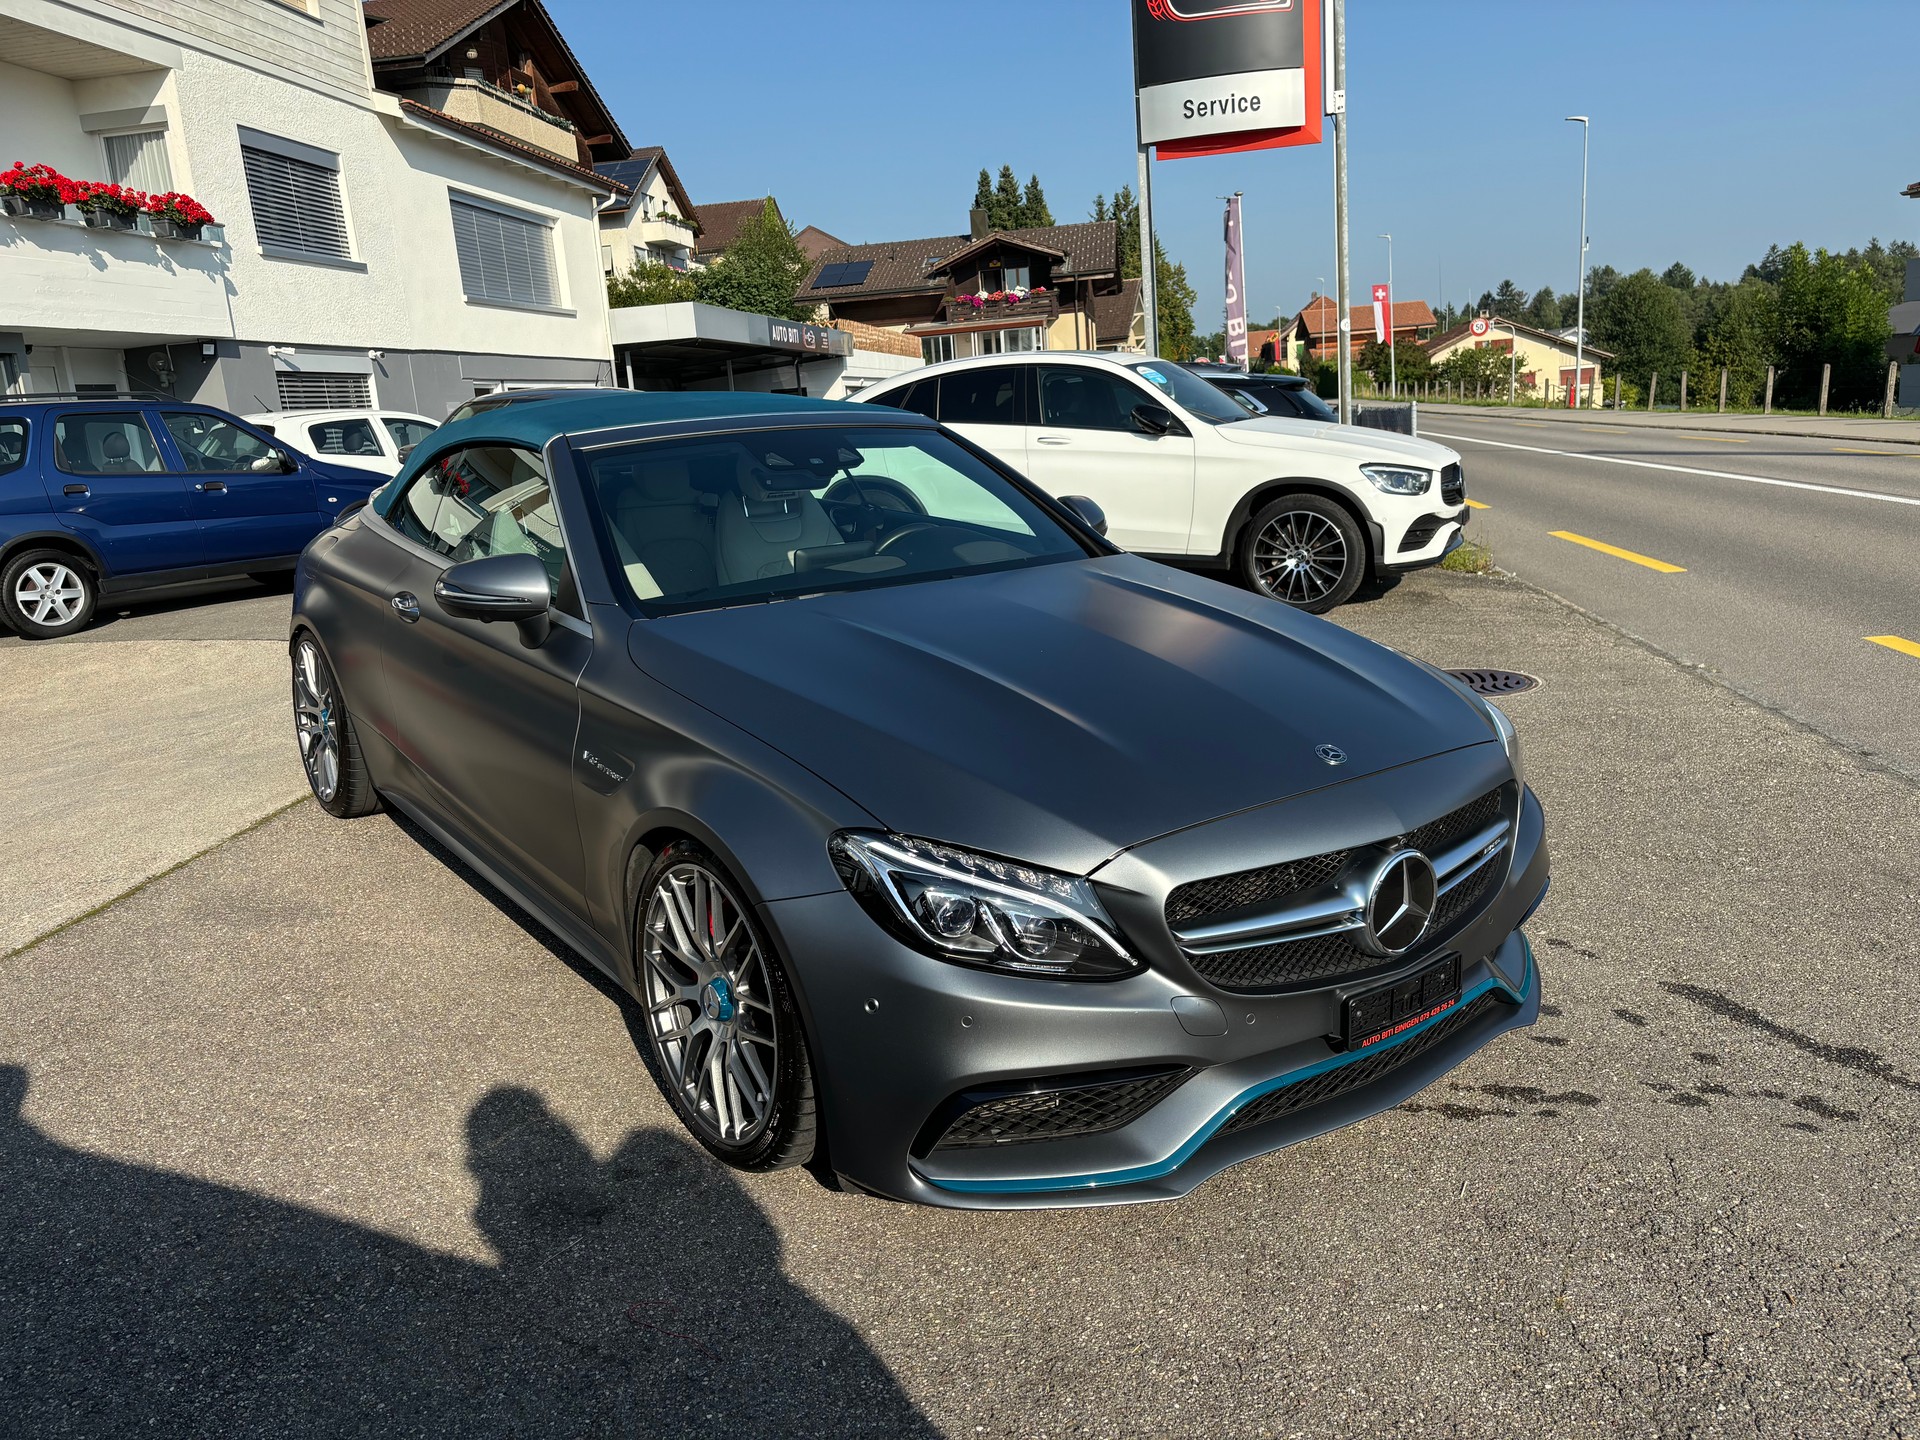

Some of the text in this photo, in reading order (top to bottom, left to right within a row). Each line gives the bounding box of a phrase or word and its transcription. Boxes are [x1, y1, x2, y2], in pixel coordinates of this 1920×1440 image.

[1183, 93, 1261, 119] Service
[772, 324, 788, 342] AUTO
[788, 327, 800, 344] BITI
[1475, 323, 1484, 331] 50
[1362, 1035, 1381, 1048] AUTO
[1381, 1027, 1394, 1040] BITI
[1394, 1016, 1420, 1034] EINIGEN
